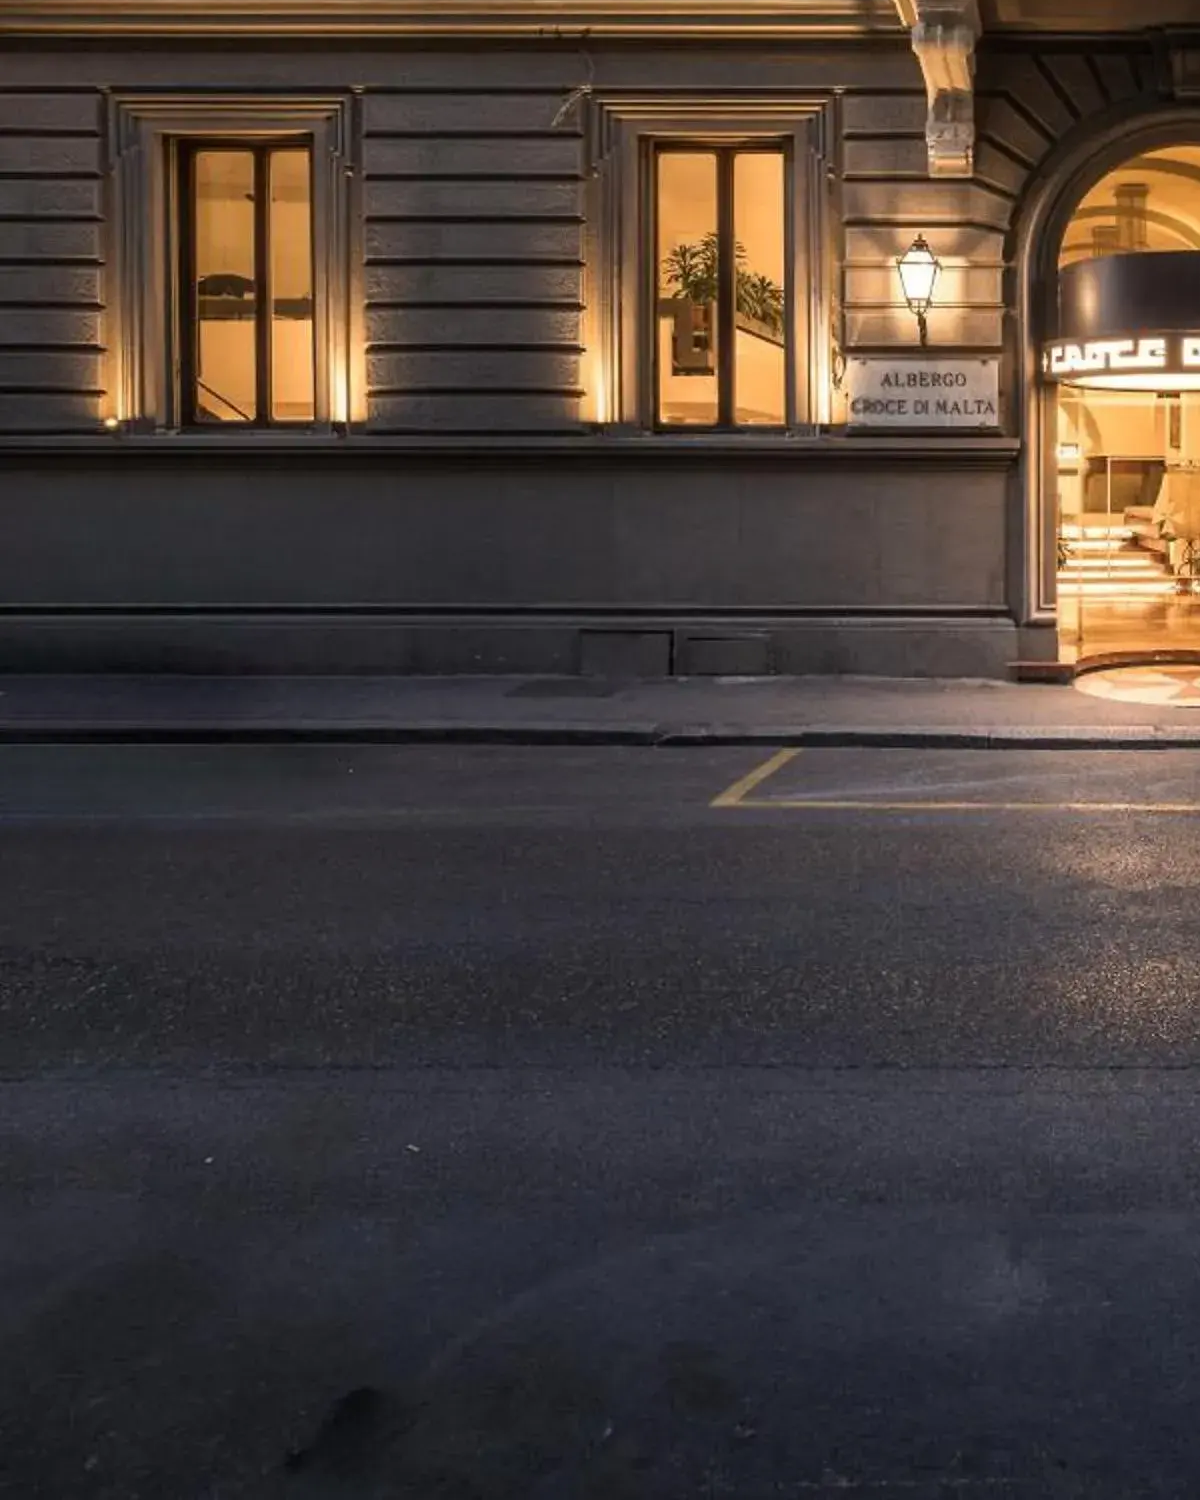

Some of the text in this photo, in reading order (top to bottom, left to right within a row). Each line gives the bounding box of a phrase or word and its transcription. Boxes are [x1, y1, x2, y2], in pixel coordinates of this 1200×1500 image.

[881, 372, 967, 388] ALBERGO
[851, 399, 995, 415] CROCE DI MALTA
